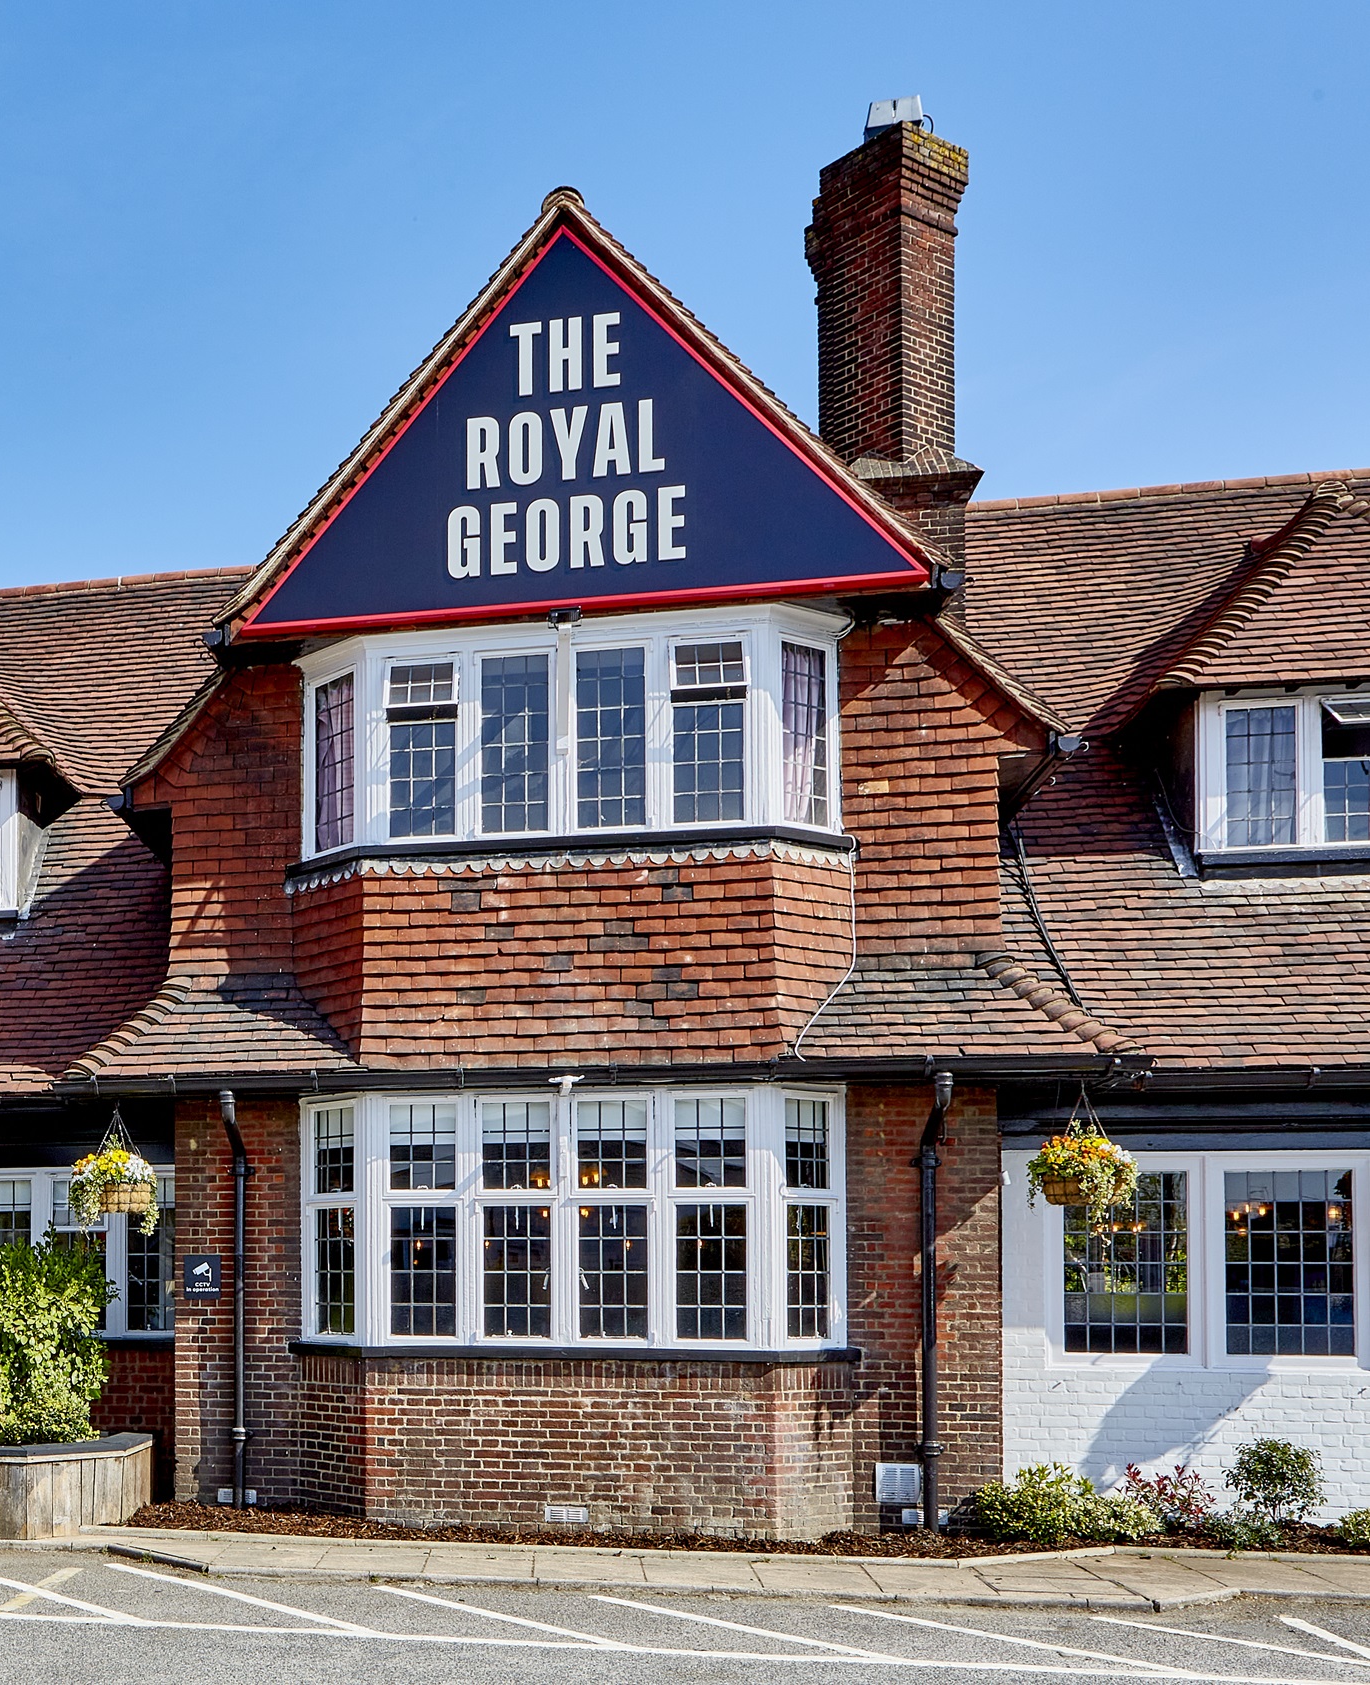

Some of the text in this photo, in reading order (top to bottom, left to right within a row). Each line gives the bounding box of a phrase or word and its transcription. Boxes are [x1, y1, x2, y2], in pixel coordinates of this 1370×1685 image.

[509, 311, 621, 397] THE
[466, 398, 666, 490] ROYAL
[447, 485, 686, 579] GEORGE
